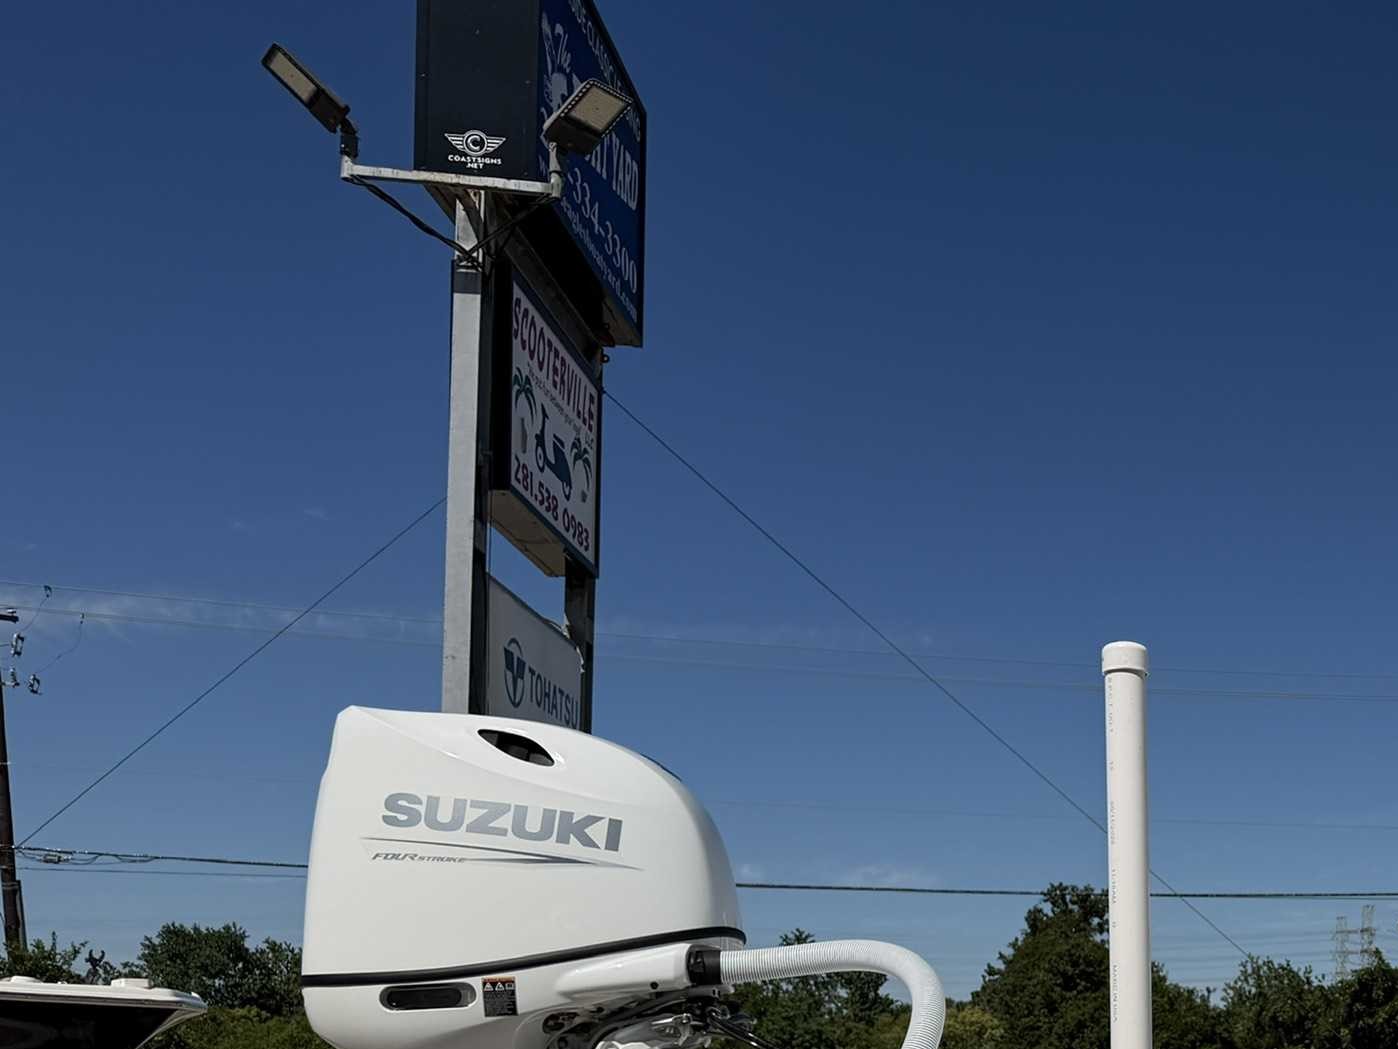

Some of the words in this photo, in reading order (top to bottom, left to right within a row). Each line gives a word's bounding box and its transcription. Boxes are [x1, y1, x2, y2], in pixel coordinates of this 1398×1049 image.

[447, 154, 502, 165] COASTSIGNS
[611, 131, 638, 211] YARD
[513, 297, 595, 434] SCOOTERVILLE
[562, 506, 590, 552] 0983
[528, 664, 579, 729] TOHATSU
[382, 792, 623, 852] SUZUKI
